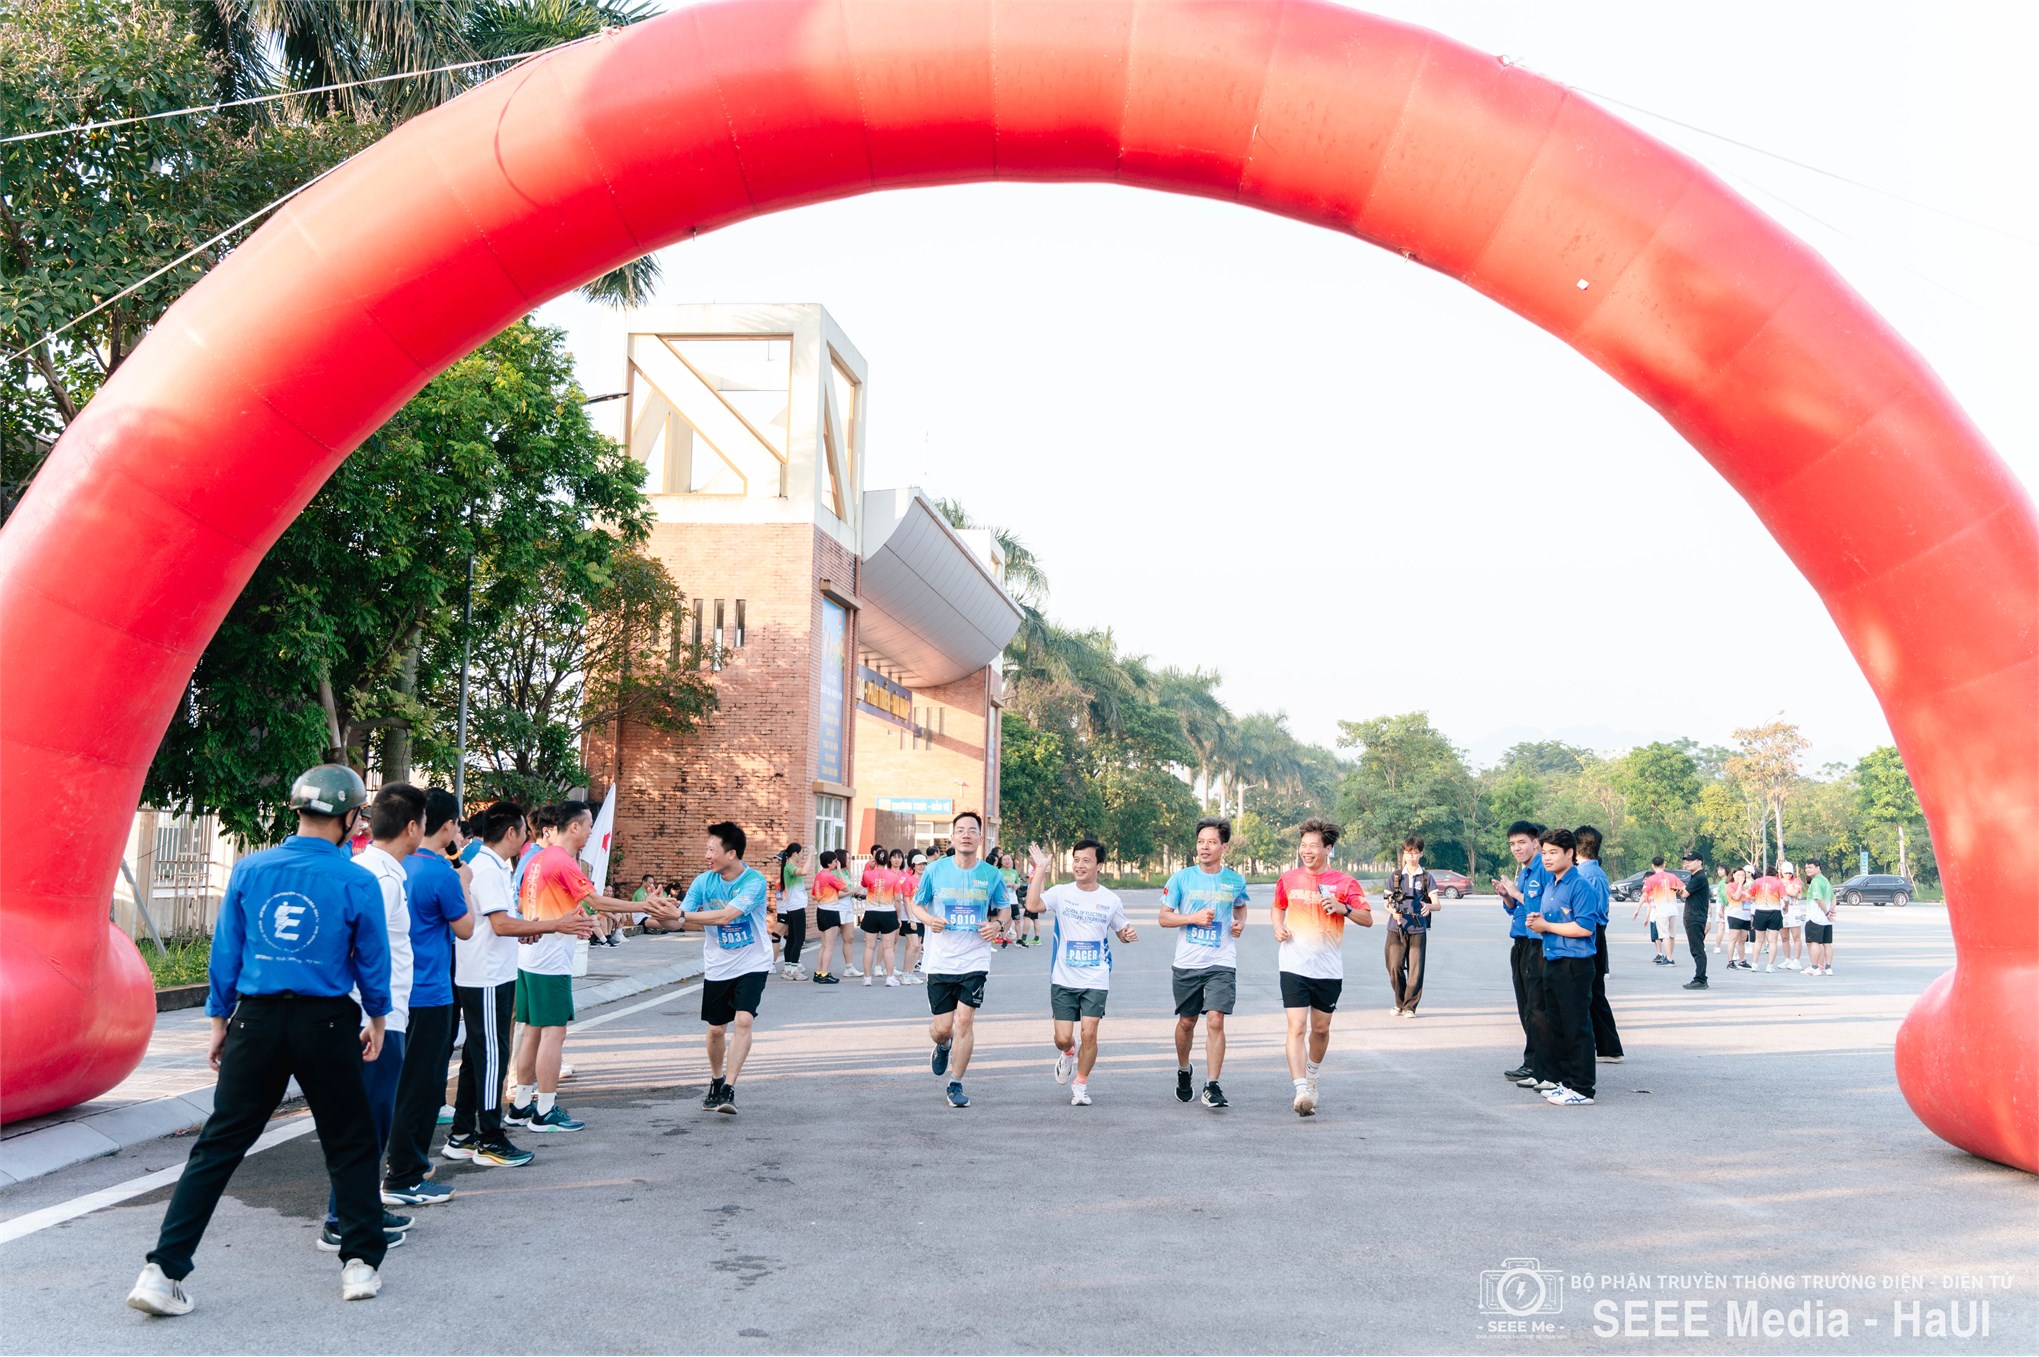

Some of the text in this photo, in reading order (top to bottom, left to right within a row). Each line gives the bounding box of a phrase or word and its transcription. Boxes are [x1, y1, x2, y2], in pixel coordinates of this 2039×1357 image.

[950, 914, 976, 925] 5010
[721, 930, 748, 943] 5031
[1191, 927, 1217, 941] 5015
[1069, 949, 1098, 960] PACER
